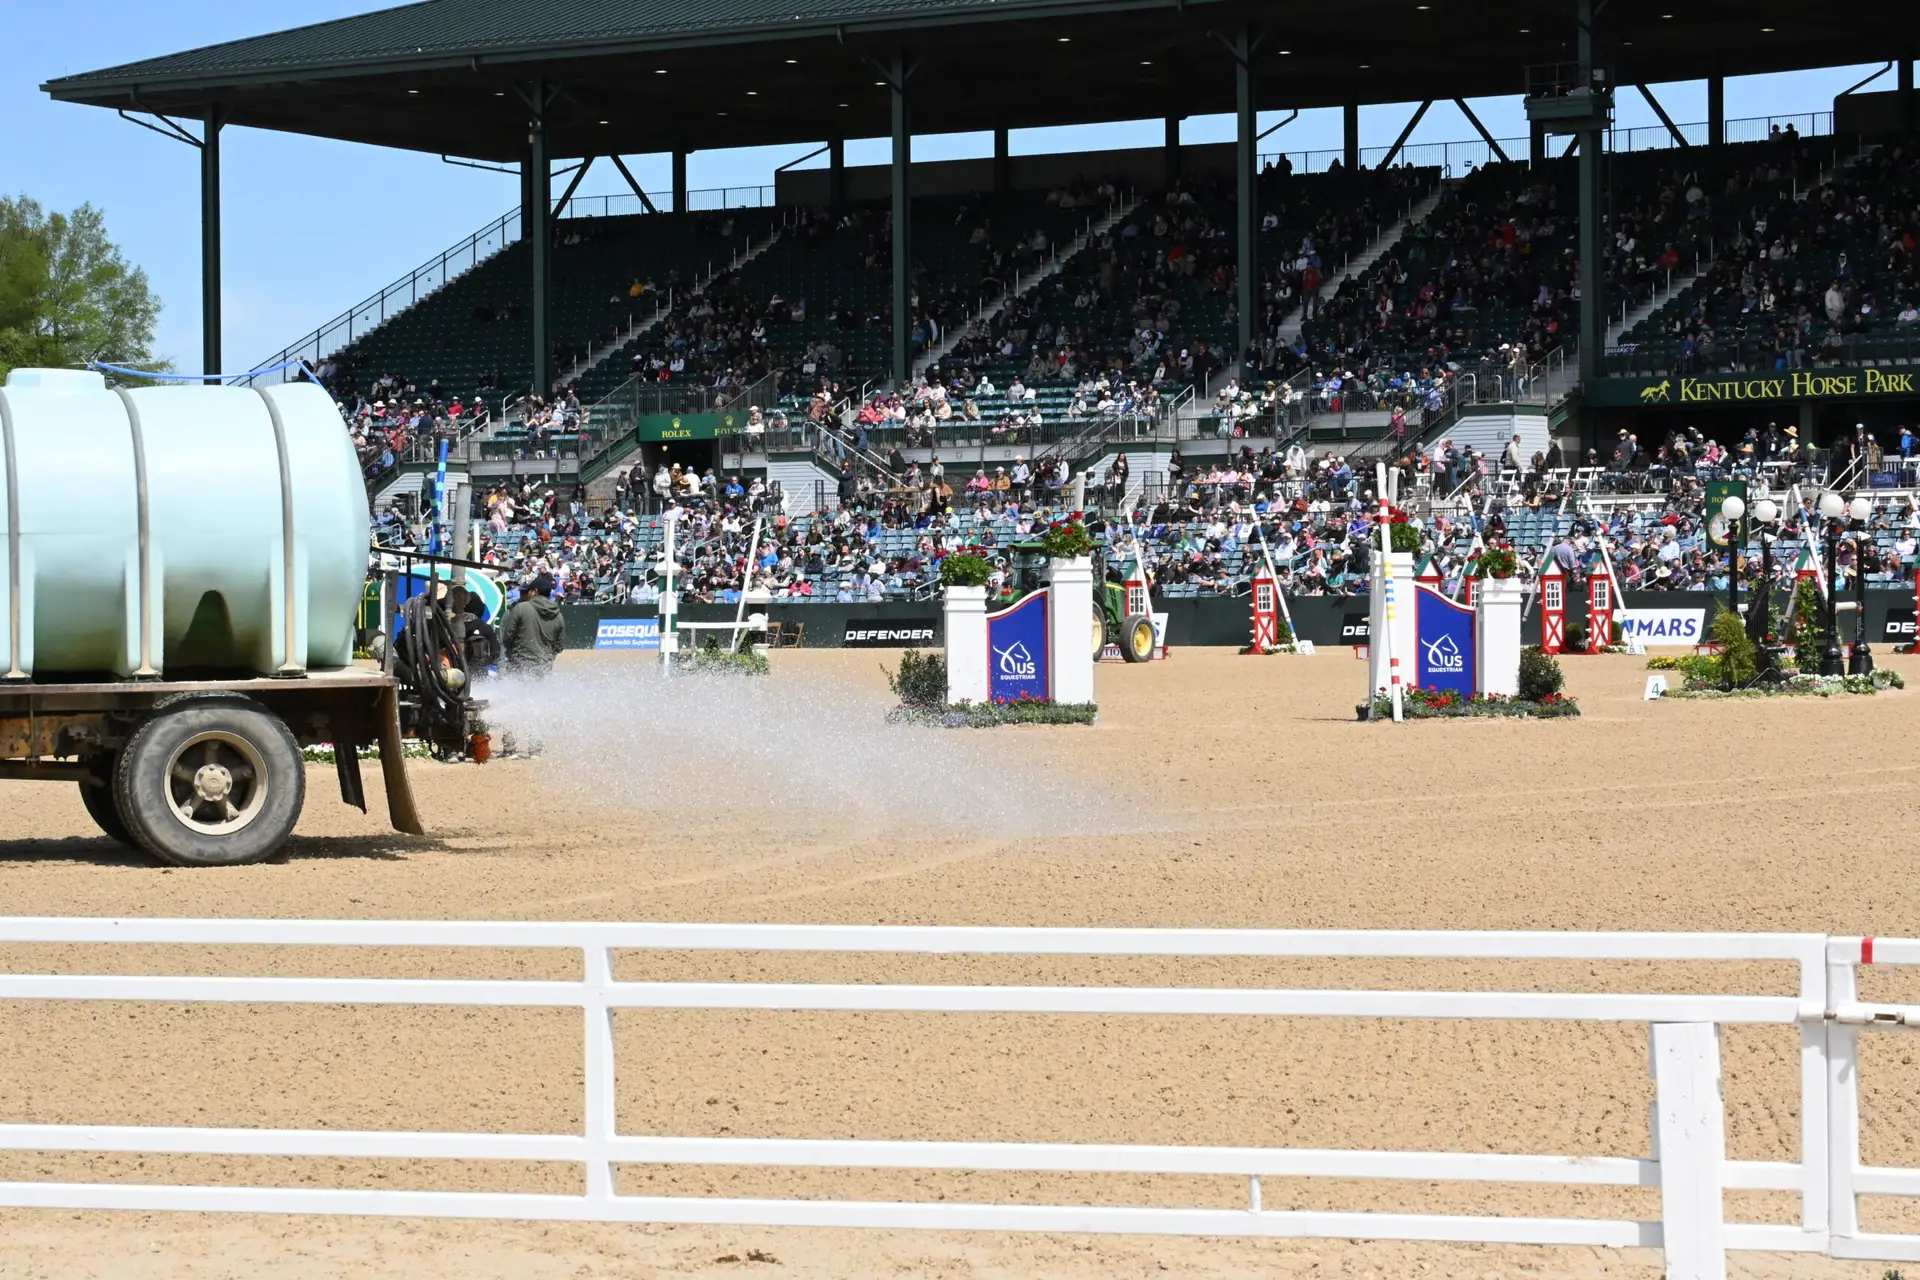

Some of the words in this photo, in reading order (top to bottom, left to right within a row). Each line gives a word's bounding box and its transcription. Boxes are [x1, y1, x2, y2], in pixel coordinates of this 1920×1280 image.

[1679, 378, 1786, 401] KENTUCKY
[1791, 372, 1857, 396] HORSE
[1864, 369, 1914, 393] PARK
[661, 429, 692, 438] ROLEX
[597, 624, 660, 638] COSEQUI
[1342, 625, 1371, 636] DE
[1636, 618, 1697, 637] MARS
[845, 629, 934, 641] DEFENDER
[1444, 655, 1463, 667] US
[1016, 662, 1036, 674] US
[1651, 682, 1660, 696] 4
